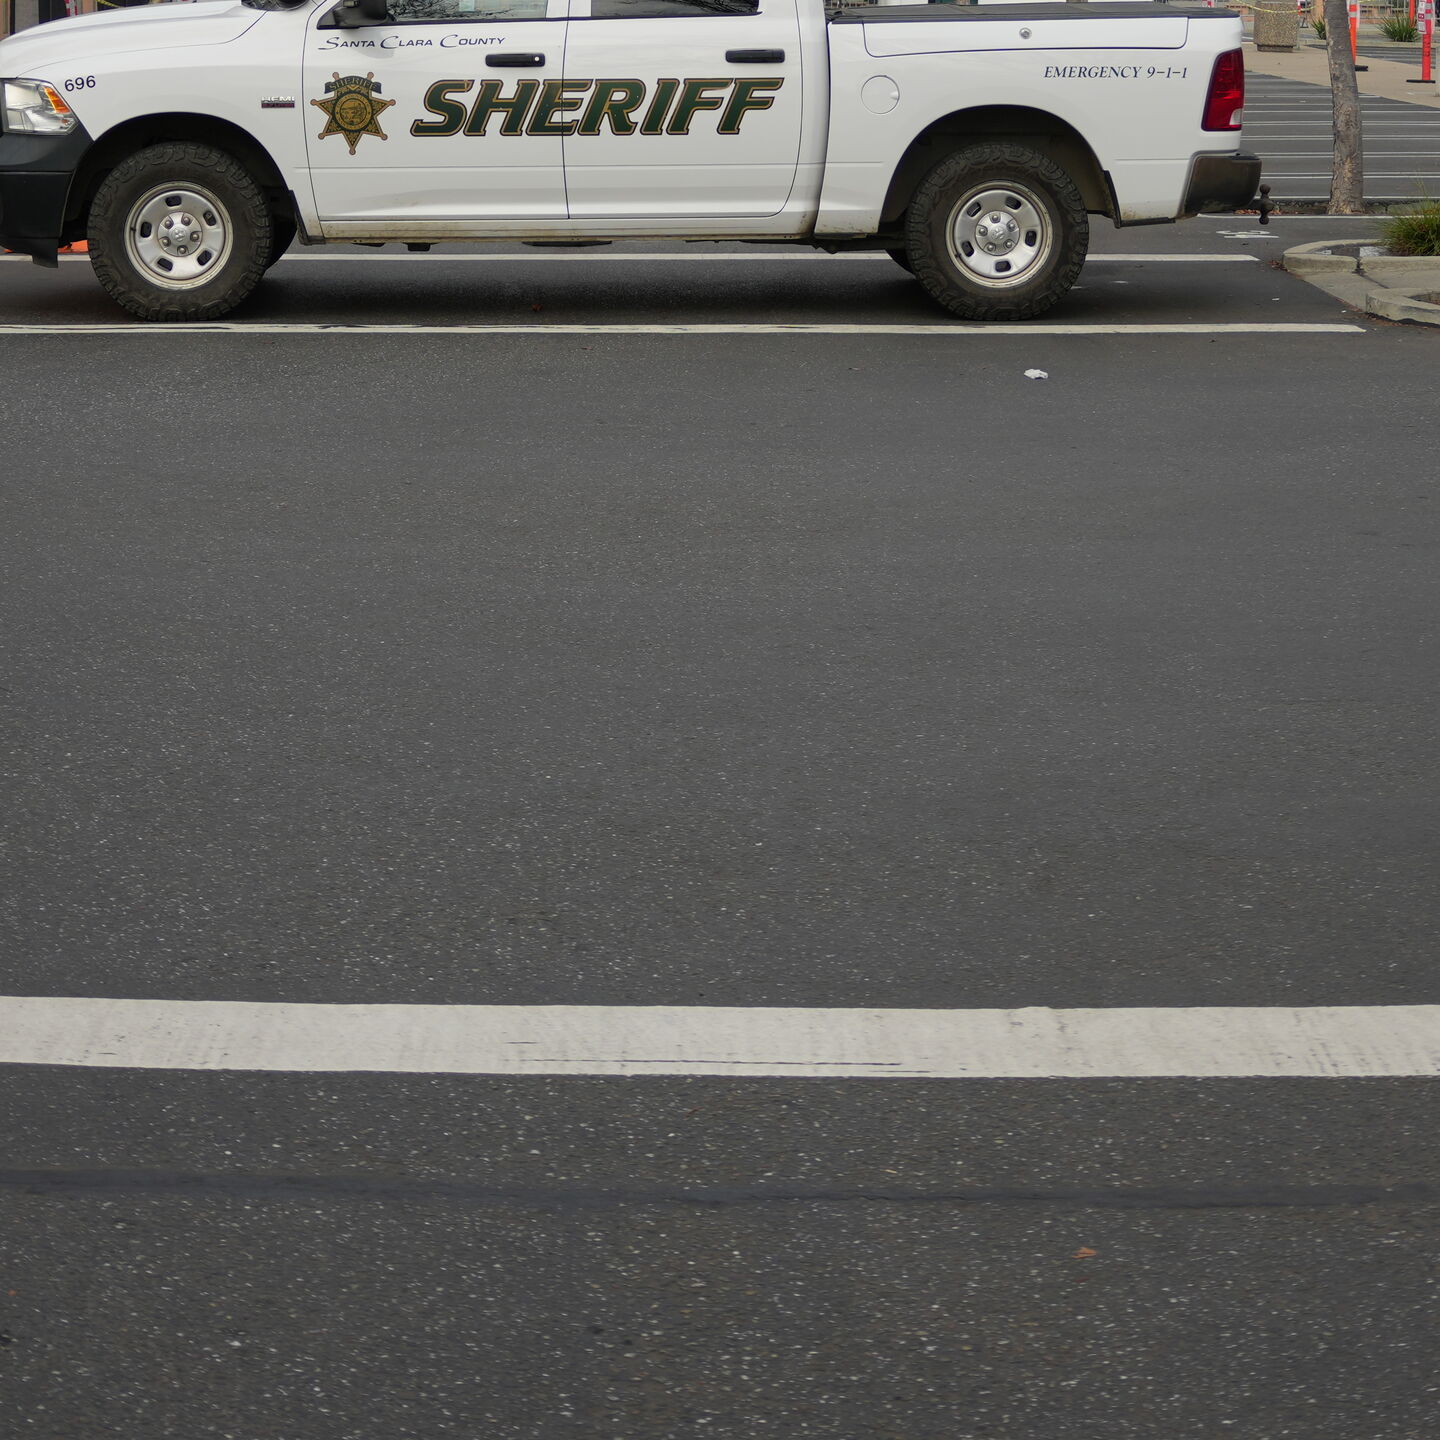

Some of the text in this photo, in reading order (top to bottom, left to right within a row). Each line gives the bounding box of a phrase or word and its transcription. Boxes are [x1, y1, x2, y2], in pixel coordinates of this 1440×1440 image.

[318, 34, 506, 50] SANTA CLARA COUNTY
[1044, 65, 1188, 78] EMERGENCY 9-1-1
[64, 75, 97, 92] 696
[329, 76, 378, 90] SHERIFF
[410, 78, 785, 137] SHERIFF
